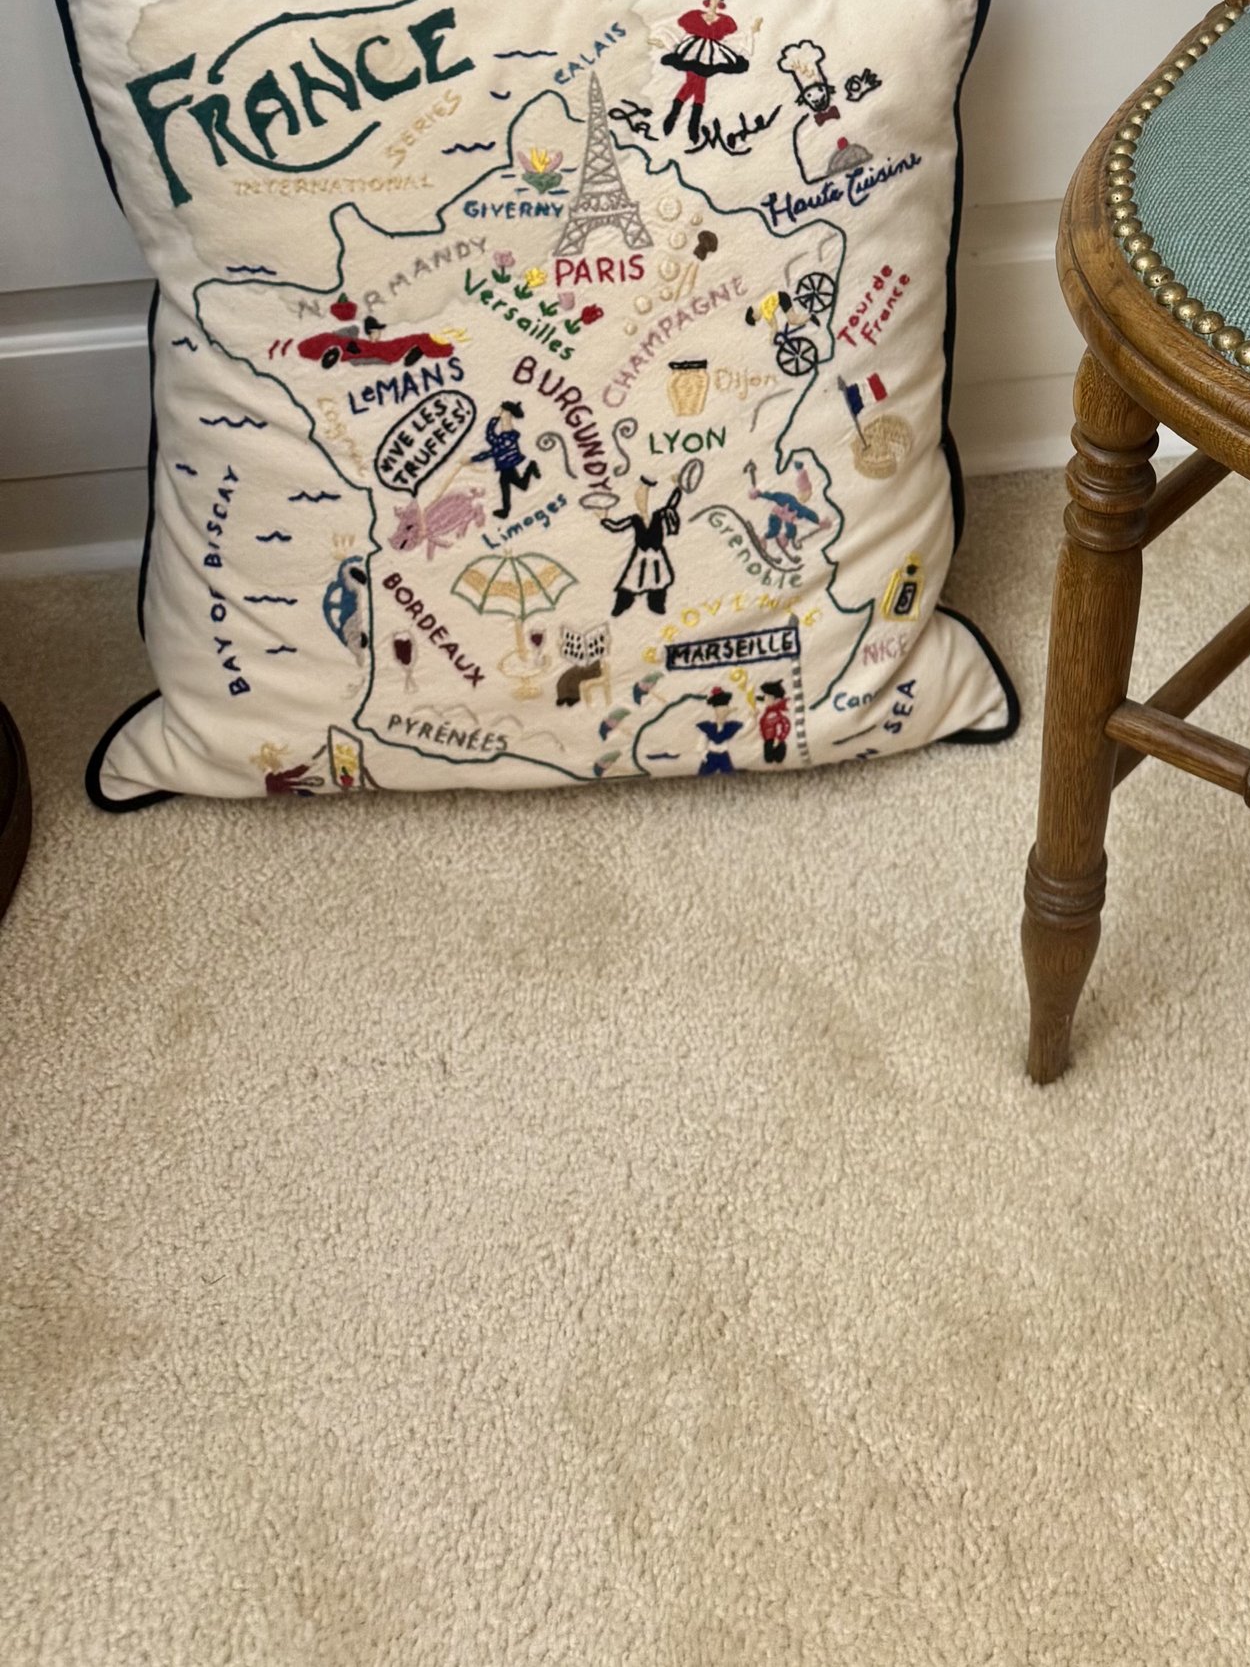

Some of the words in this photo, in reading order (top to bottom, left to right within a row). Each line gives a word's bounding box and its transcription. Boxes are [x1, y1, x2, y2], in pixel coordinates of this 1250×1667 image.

[554, 21, 627, 85] CALAIS
[126, 7, 476, 207] FRANCE
[232, 174, 435, 196] INTERNATIONAL
[385, 88, 463, 169] SERIES
[608, 99, 659, 141] La
[684, 104, 782, 156] Mode
[463, 200, 563, 220] GIVERNY
[761, 181, 845, 227] Haute
[846, 153, 922, 208] Cuisine
[555, 254, 645, 287] PARIS
[836, 291, 873, 347] Tour
[872, 264, 893, 291] de
[464, 268, 575, 361] Versailles
[602, 274, 748, 408] CHAMPAGNE
[860, 274, 911, 347] France
[714, 366, 778, 400] Dijon
[380, 430, 414, 473] VIVE
[412, 399, 448, 432] LES
[512, 355, 613, 491] BURGUNDY
[649, 426, 726, 454] LYON
[203, 465, 239, 568] BISCAY
[482, 493, 567, 550] Limoges
[708, 511, 803, 589] Grenoble
[214, 636, 251, 696] BAY
[382, 572, 486, 688] BORDEAUX
[671, 631, 794, 665] MARSEILLE
[883, 679, 917, 734] SEA
